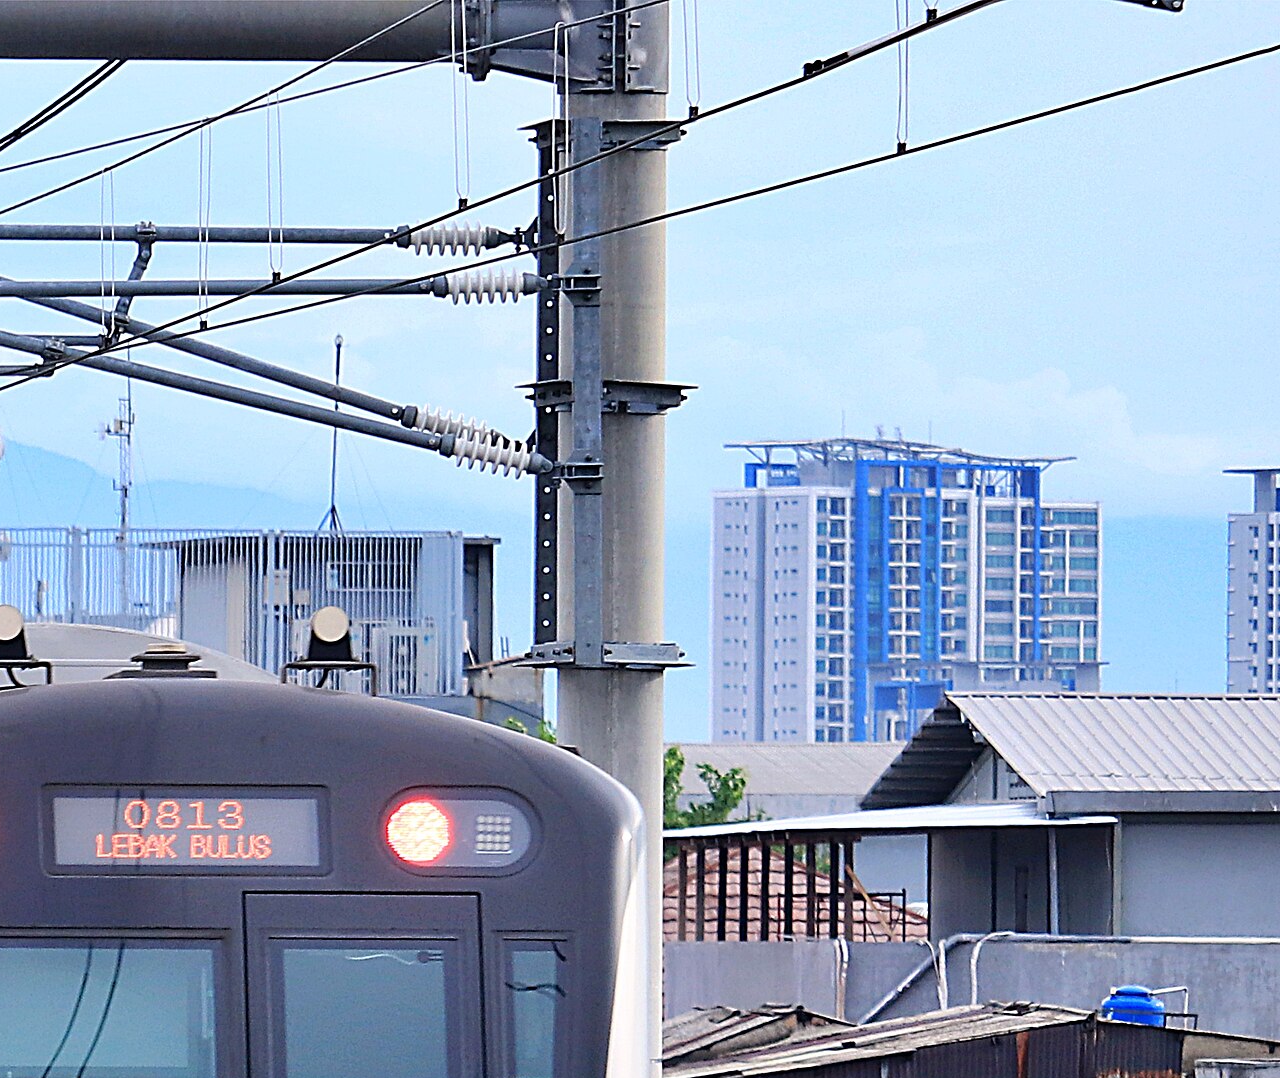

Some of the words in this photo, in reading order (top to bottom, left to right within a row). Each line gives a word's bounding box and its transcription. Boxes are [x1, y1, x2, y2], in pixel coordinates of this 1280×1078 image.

[124, 799, 245, 830] 0813
[95, 833, 177, 860] LEBAK
[189, 833, 272, 860] BULUS
